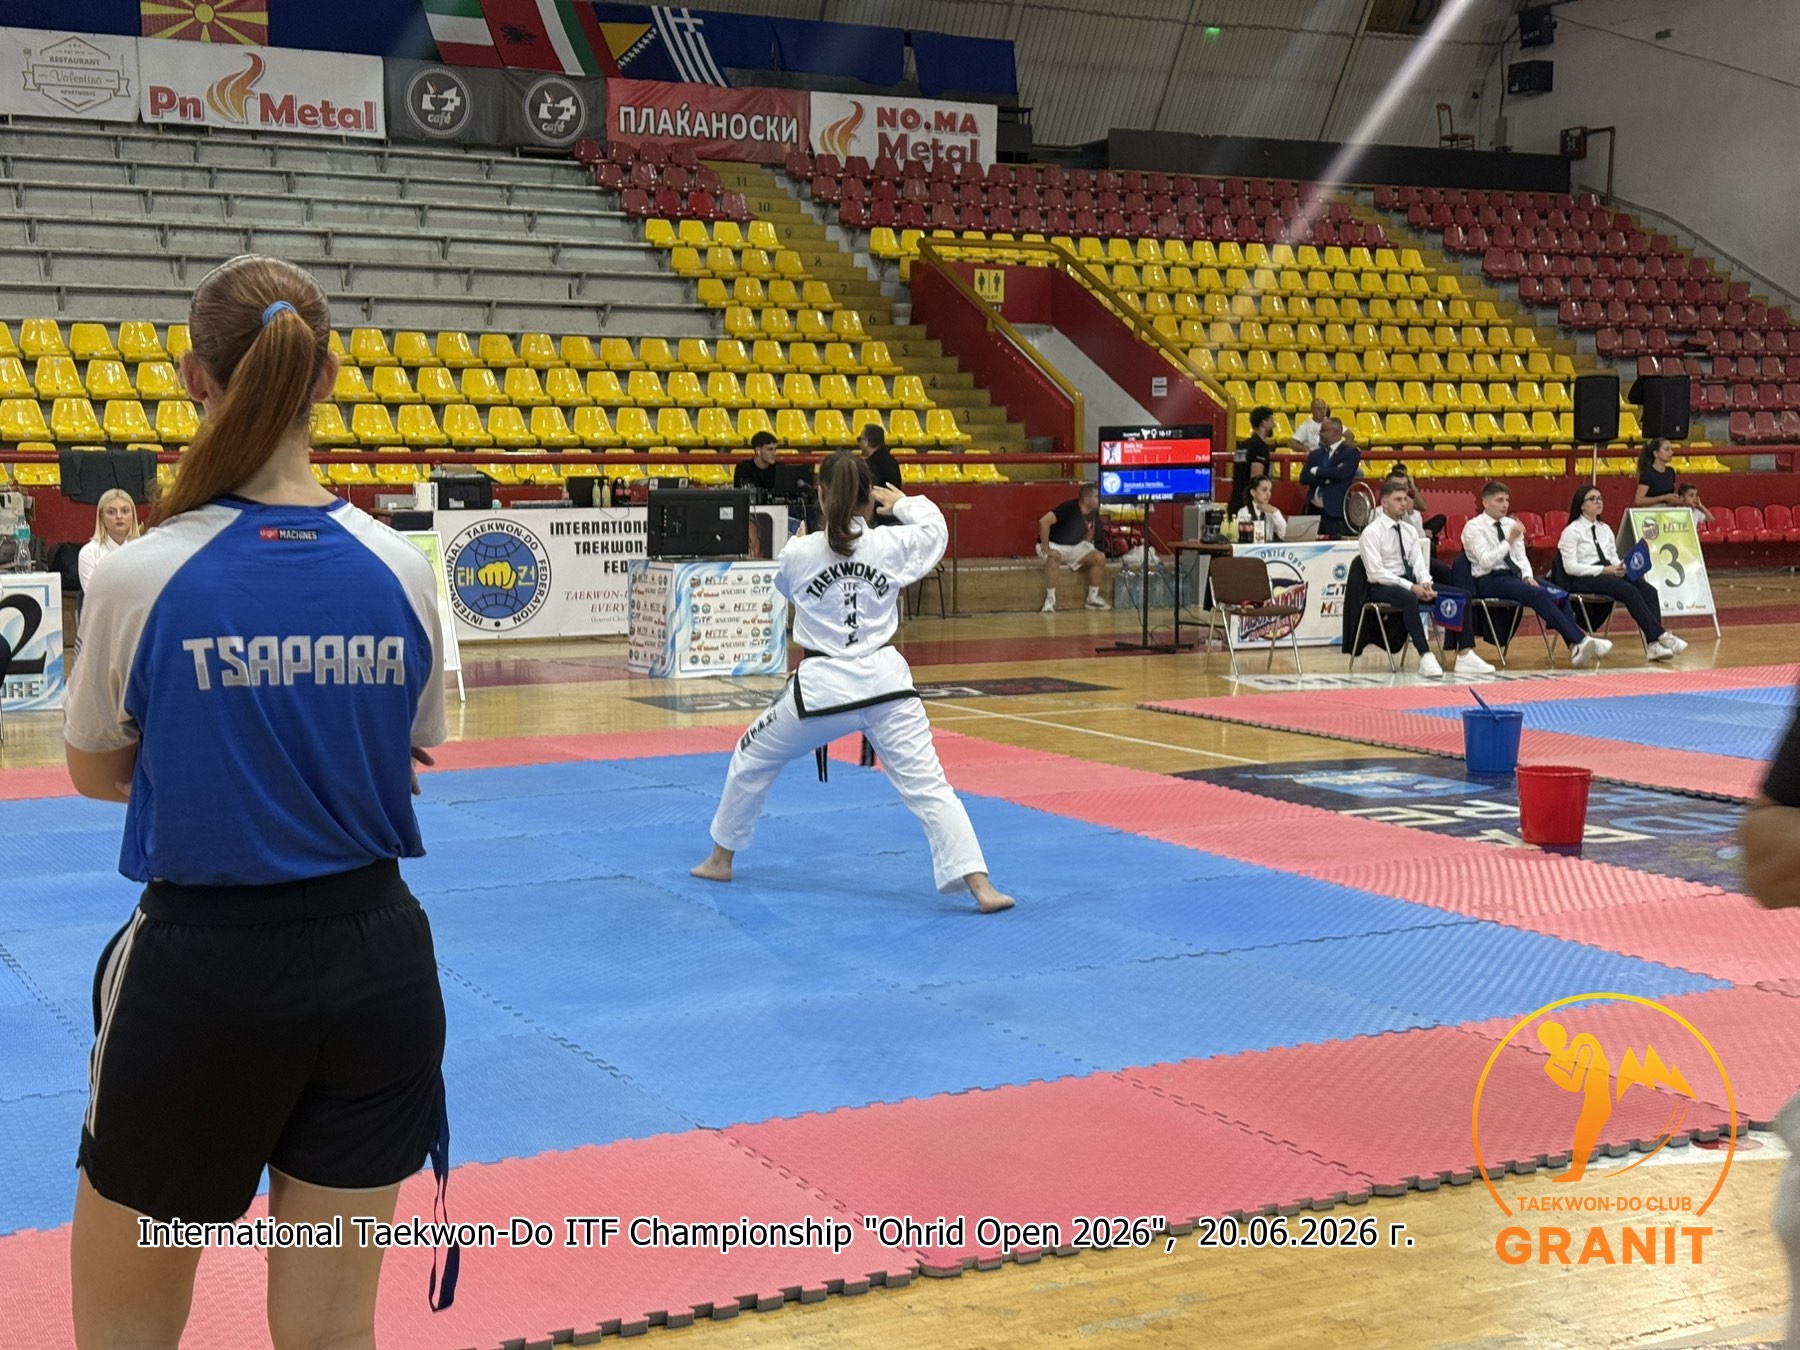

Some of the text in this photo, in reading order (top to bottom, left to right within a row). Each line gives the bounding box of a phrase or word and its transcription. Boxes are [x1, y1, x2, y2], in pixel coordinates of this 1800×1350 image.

[49, 55, 100, 66] RESTAURANT
[149, 85, 377, 130] Pn Metal
[876, 106, 979, 133] NO.MA
[618, 102, 799, 144] ПЛАЌАНОСКИ
[877, 132, 981, 163] Metal
[868, 312, 877, 324] 6
[963, 409, 970, 422] 3
[279, 529, 318, 540] MACHINES
[465, 522, 539, 551] TAEKWON-DO
[1260, 549, 1306, 573] Ohrid Open
[1659, 543, 1686, 588] 3
[457, 566, 475, 587] 태
[806, 561, 890, 598] TAEKWON-DO
[512, 559, 548, 625] FEDERATION
[0, 593, 47, 674] 2
[182, 635, 406, 690] TSAPARA
